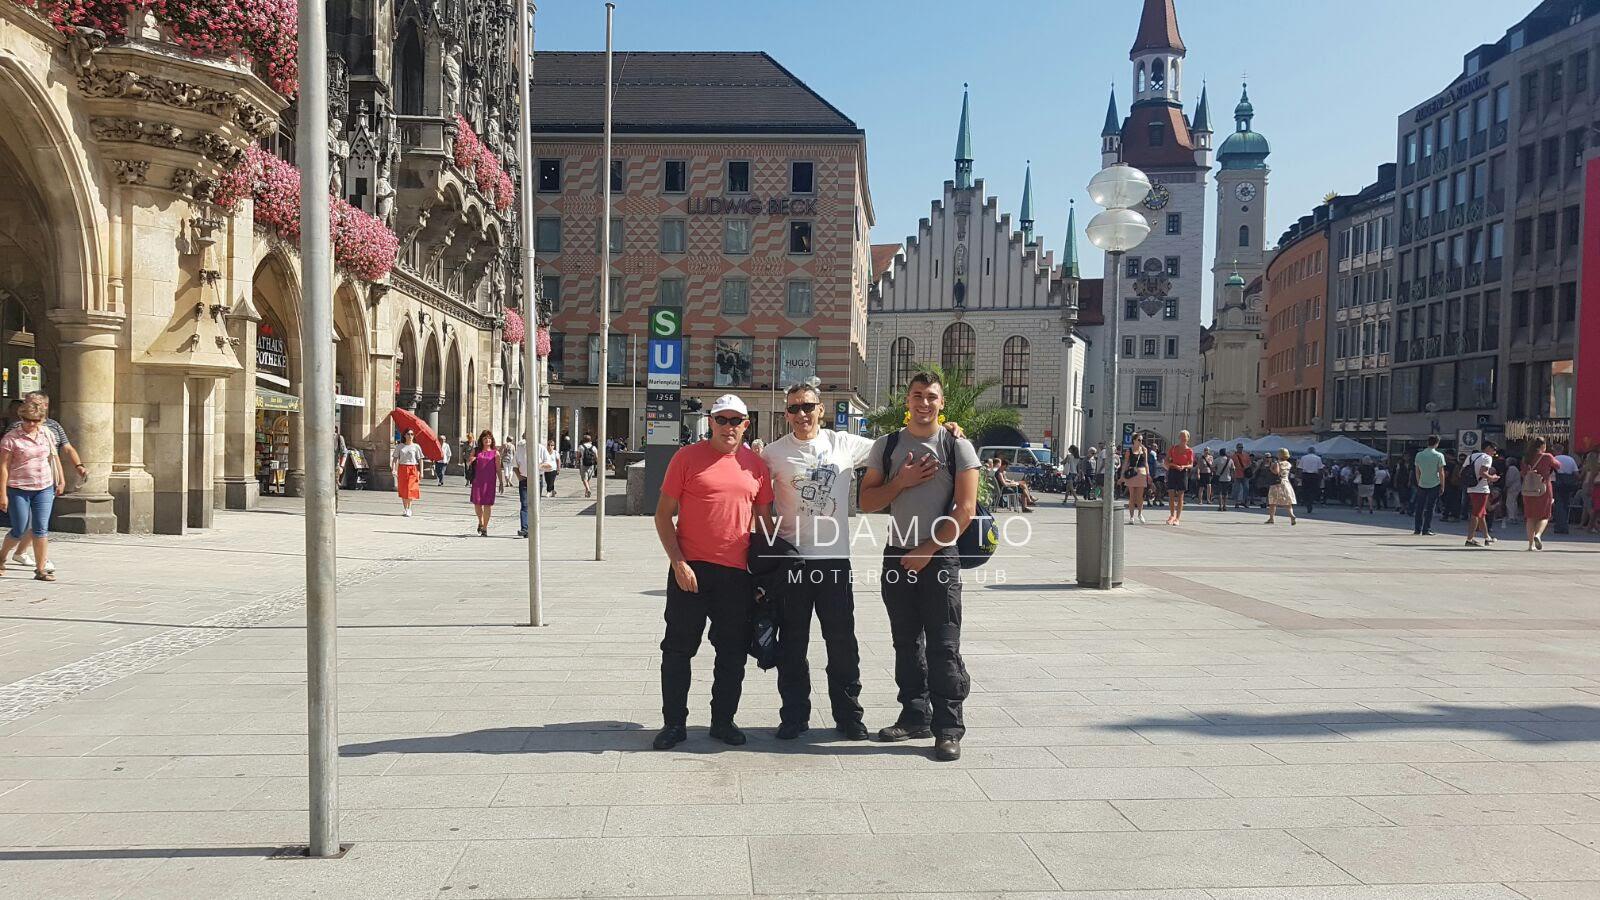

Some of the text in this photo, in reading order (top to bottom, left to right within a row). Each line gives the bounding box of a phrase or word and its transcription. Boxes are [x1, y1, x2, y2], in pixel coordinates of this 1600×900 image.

[687, 197, 818, 216] LUDWIG BECK
[655, 310, 676, 336] S
[256, 335, 283, 353] ATHAUS
[256, 350, 287, 368] POTHEKE
[654, 344, 674, 369] U
[784, 358, 811, 367] HUGO
[838, 402, 846, 413] S
[837, 414, 846, 424] U
